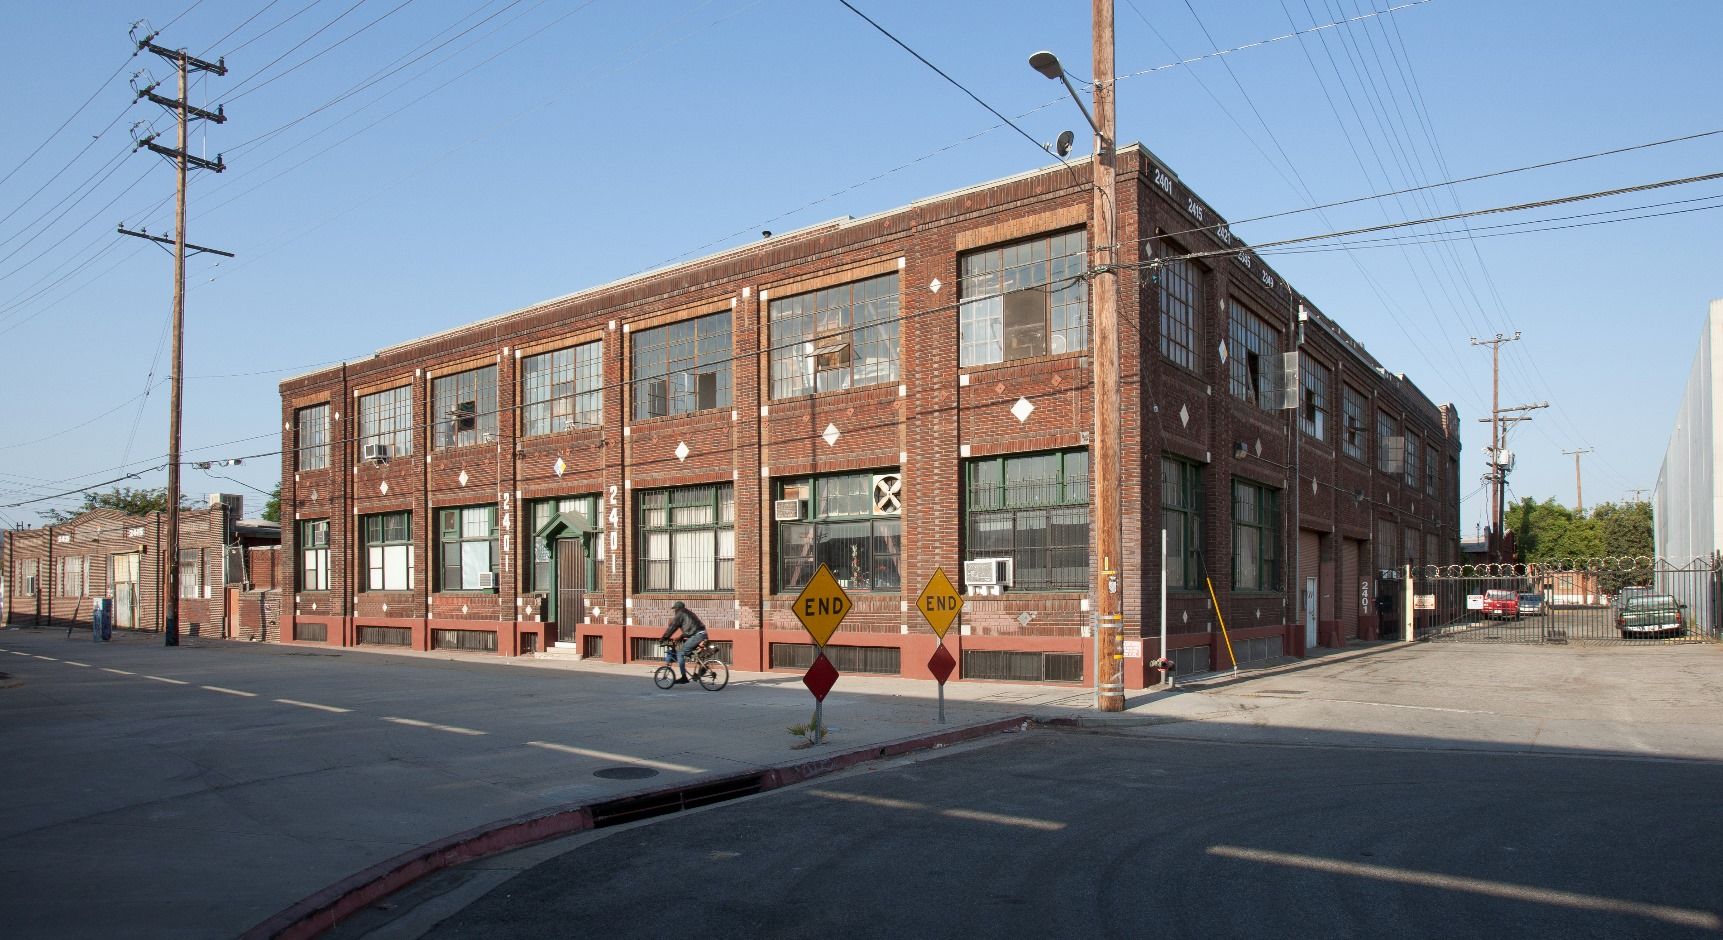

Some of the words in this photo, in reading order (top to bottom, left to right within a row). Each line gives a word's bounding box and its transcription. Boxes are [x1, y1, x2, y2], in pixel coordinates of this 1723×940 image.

[1154, 169, 1172, 195] 2401
[1188, 198, 1203, 220] 2415
[1216, 223, 1231, 245] 2421
[503, 492, 511, 572] 2401
[609, 485, 618, 573] 2401
[805, 597, 843, 616] END
[927, 596, 956, 611] END
[1361, 581, 1369, 614] 2401
